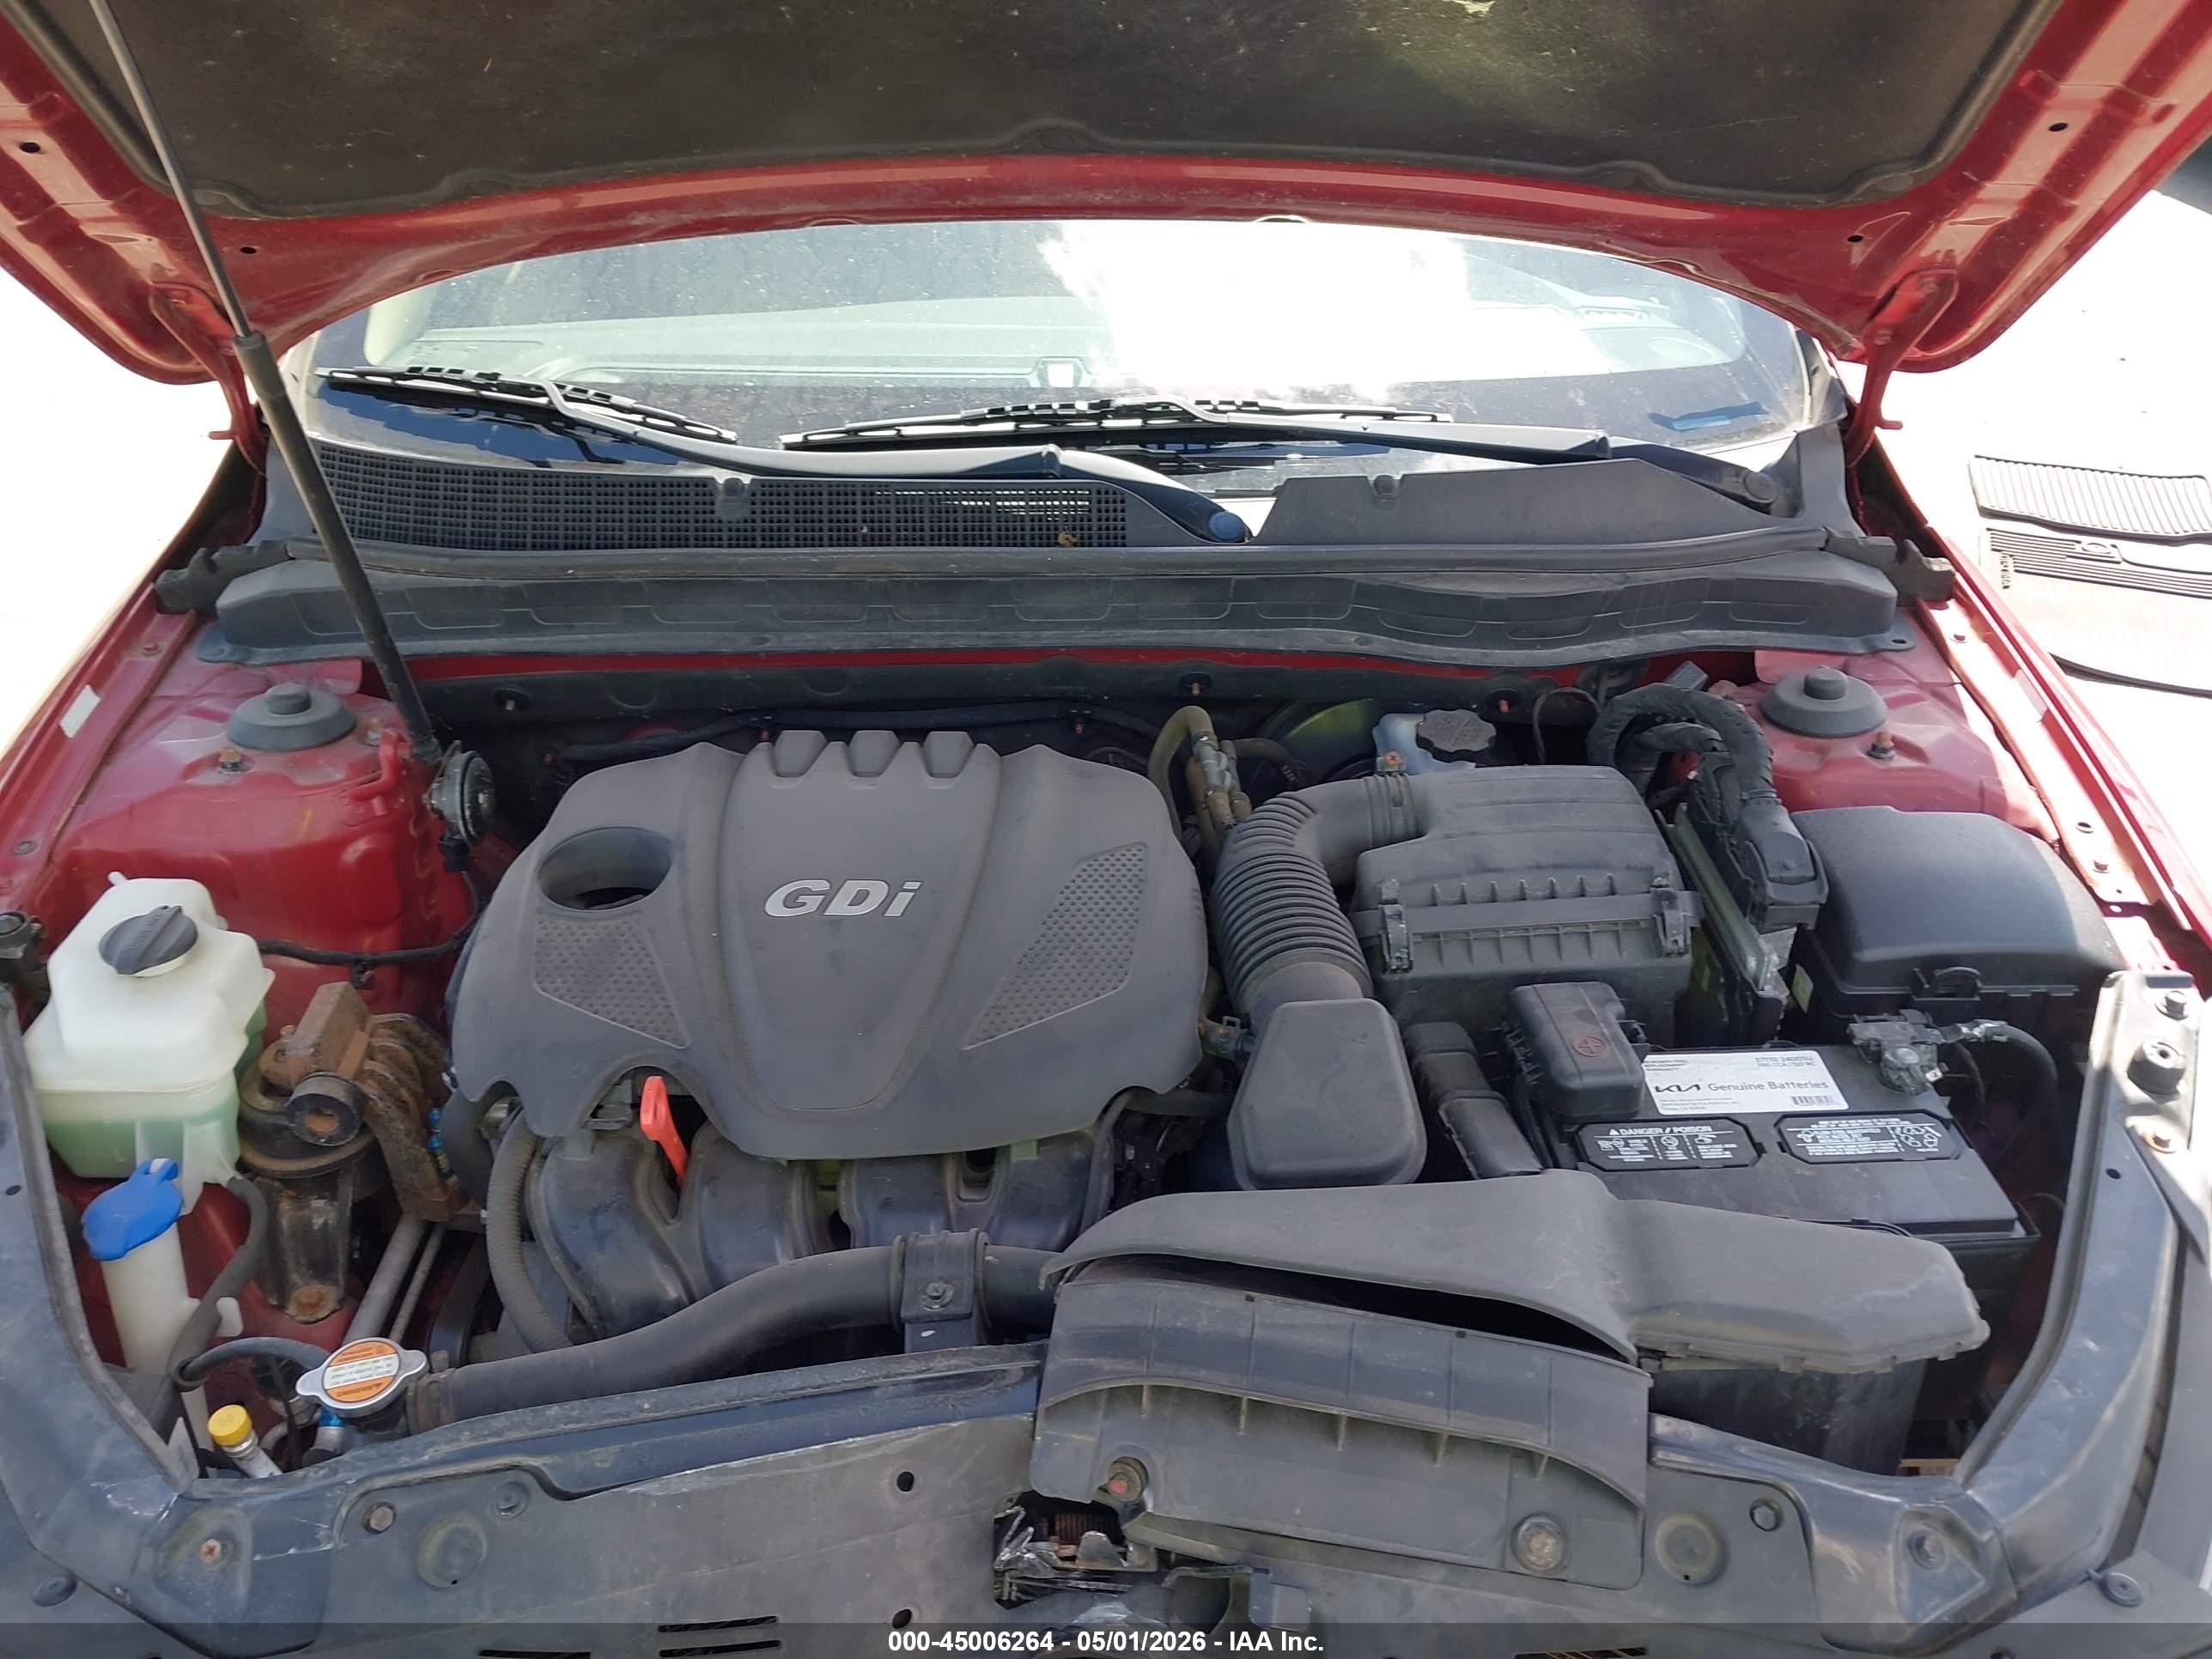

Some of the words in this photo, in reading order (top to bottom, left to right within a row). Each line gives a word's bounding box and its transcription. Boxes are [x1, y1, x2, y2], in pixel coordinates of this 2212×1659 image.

[763, 878, 923, 917] GDi
[1707, 1082, 1766, 1091] Genuine
[1769, 1080, 1829, 1091] Batteries
